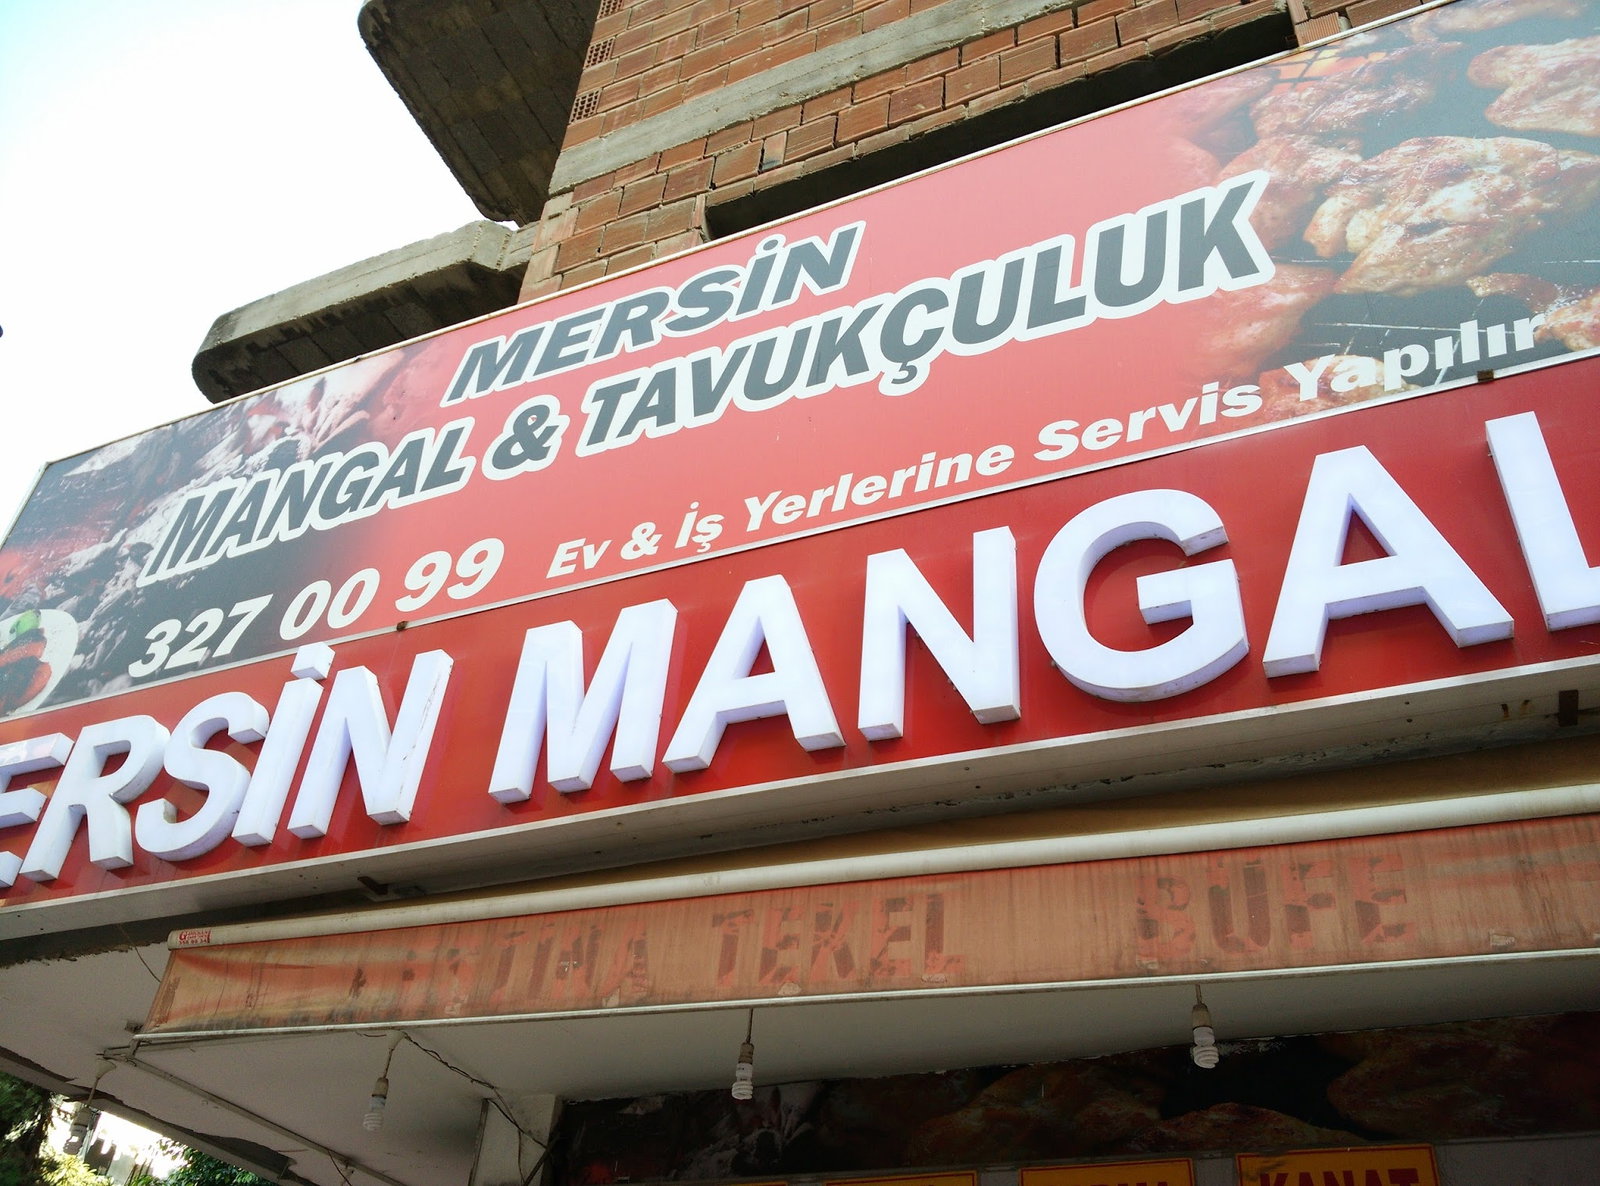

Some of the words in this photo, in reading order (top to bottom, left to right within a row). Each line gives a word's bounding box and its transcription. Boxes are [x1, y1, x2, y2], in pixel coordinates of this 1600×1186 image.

[137, 416, 476, 587] MANGAL
[482, 394, 570, 480] &
[575, 170, 1275, 457] TAVUKÇULUK
[440, 221, 867, 408] MERSİN
[546, 538, 610, 579] Ev
[620, 521, 662, 561] &
[674, 502, 725, 553] İş
[743, 443, 1015, 532] Yerlerine
[1033, 380, 1263, 462] Servis
[1284, 311, 1548, 402] Yapılır
[128, 595, 274, 678] 327
[279, 568, 380, 641] 00
[395, 538, 505, 612] 99
[487, 411, 1600, 803] MANGAL
